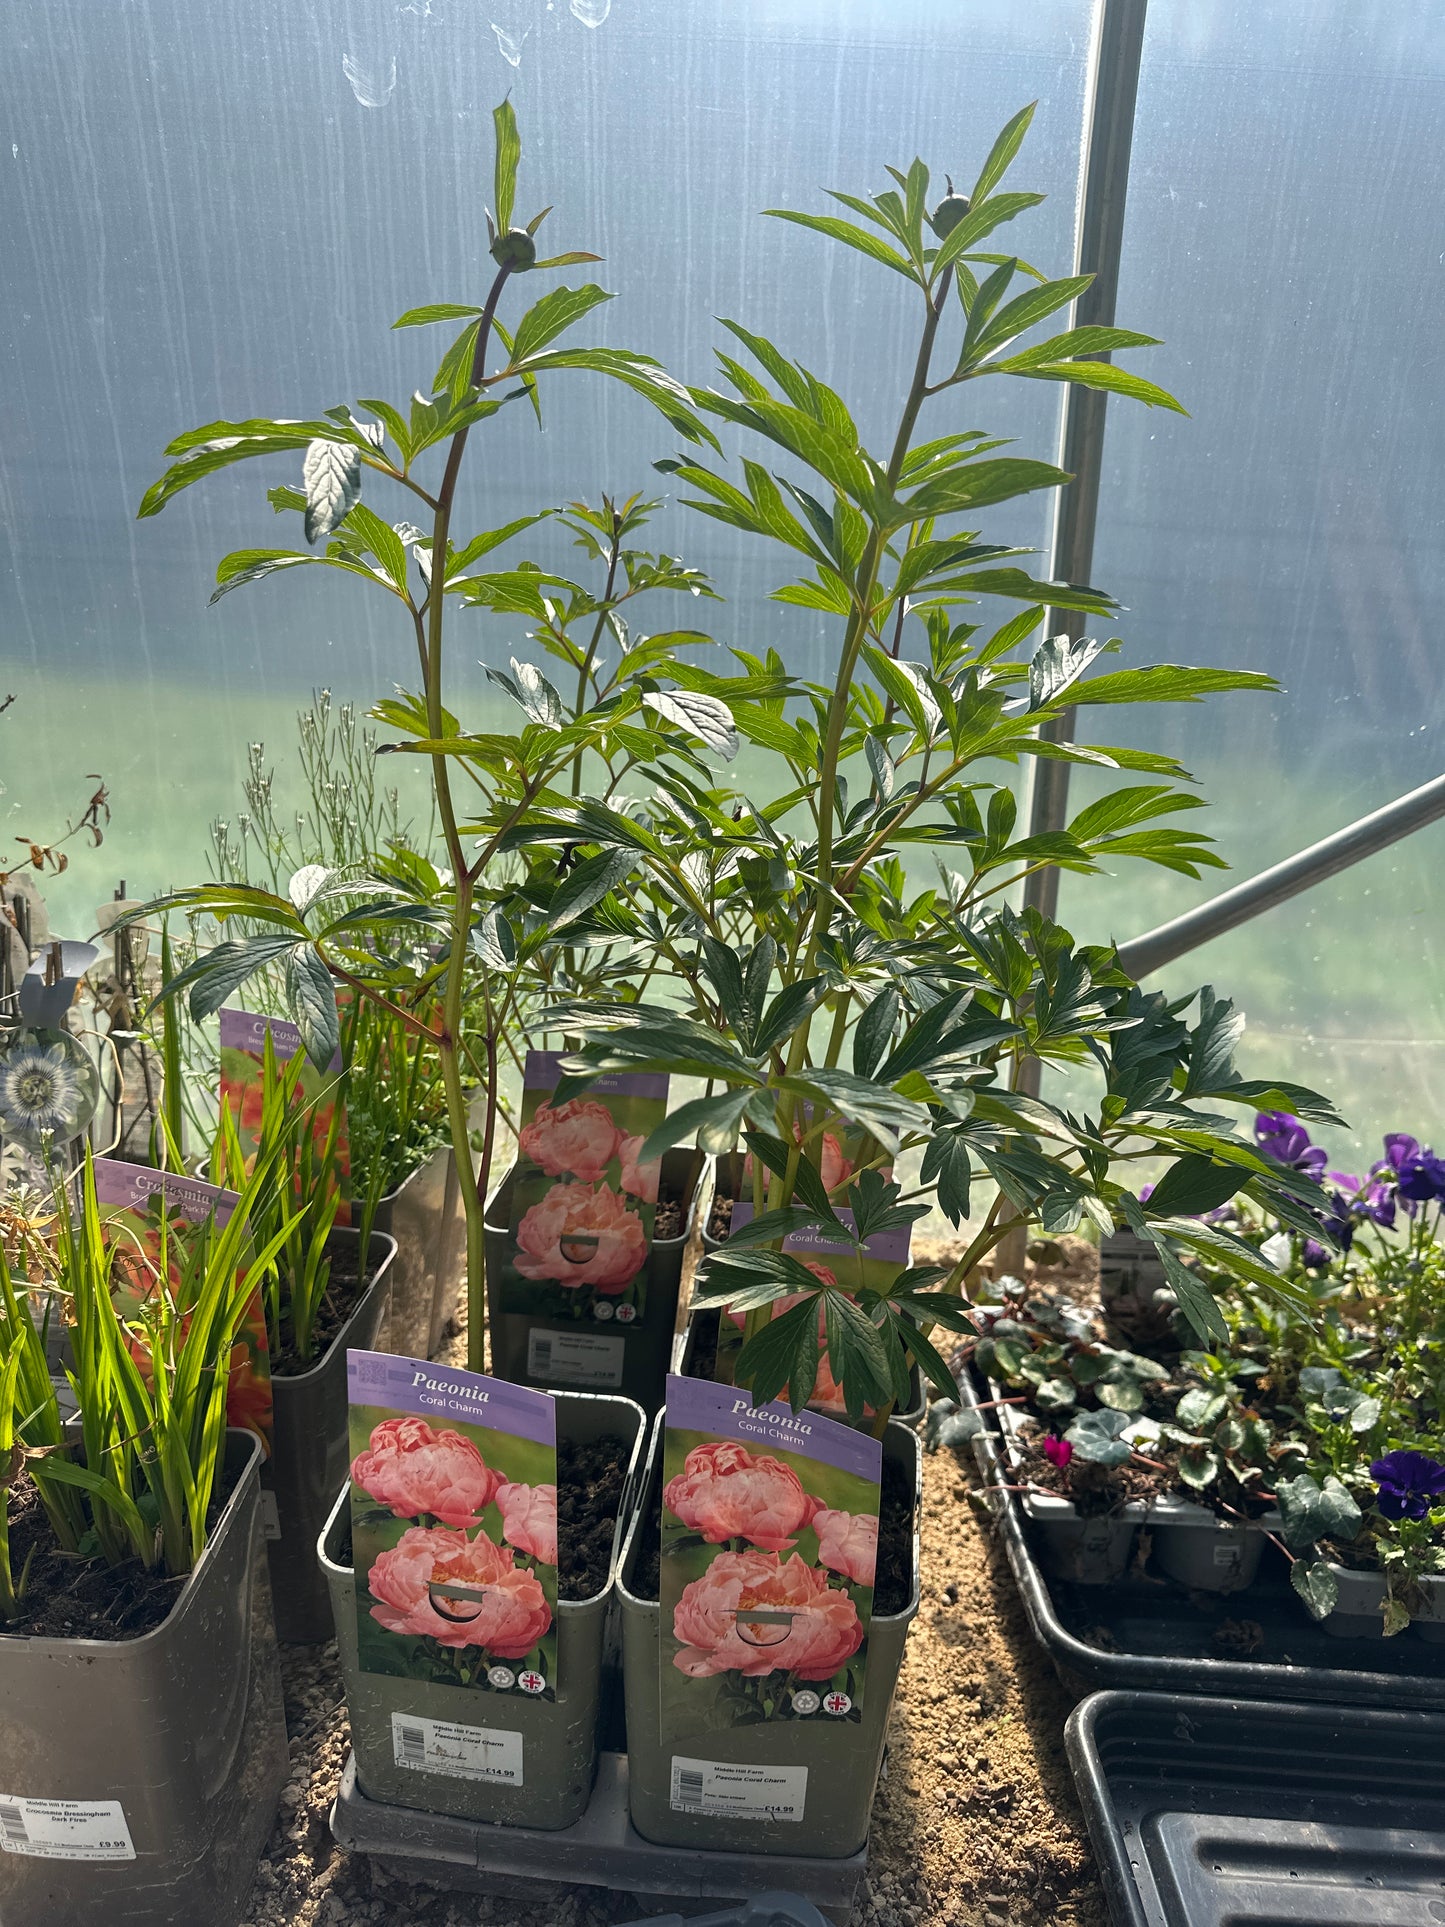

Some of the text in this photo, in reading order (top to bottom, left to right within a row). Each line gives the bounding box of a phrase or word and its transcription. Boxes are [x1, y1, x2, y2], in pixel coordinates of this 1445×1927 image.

[253, 1022, 302, 1044] Crcosm
[790, 1233, 842, 1246] Coral Cha
[411, 1371, 490, 1403] Paeonia
[419, 1393, 446, 1408] Coral
[448, 1398, 483, 1416] Charm
[731, 1399, 813, 1436] Paeonia
[738, 1420, 805, 1446] Coral Charm
[482, 1739, 504, 1748] Charm
[485, 1767, 515, 1777] £14.99
[715, 1774, 742, 1782] Paeonia
[25, 1807, 62, 1816] Crocosmia
[764, 1805, 794, 1813] £14.99
